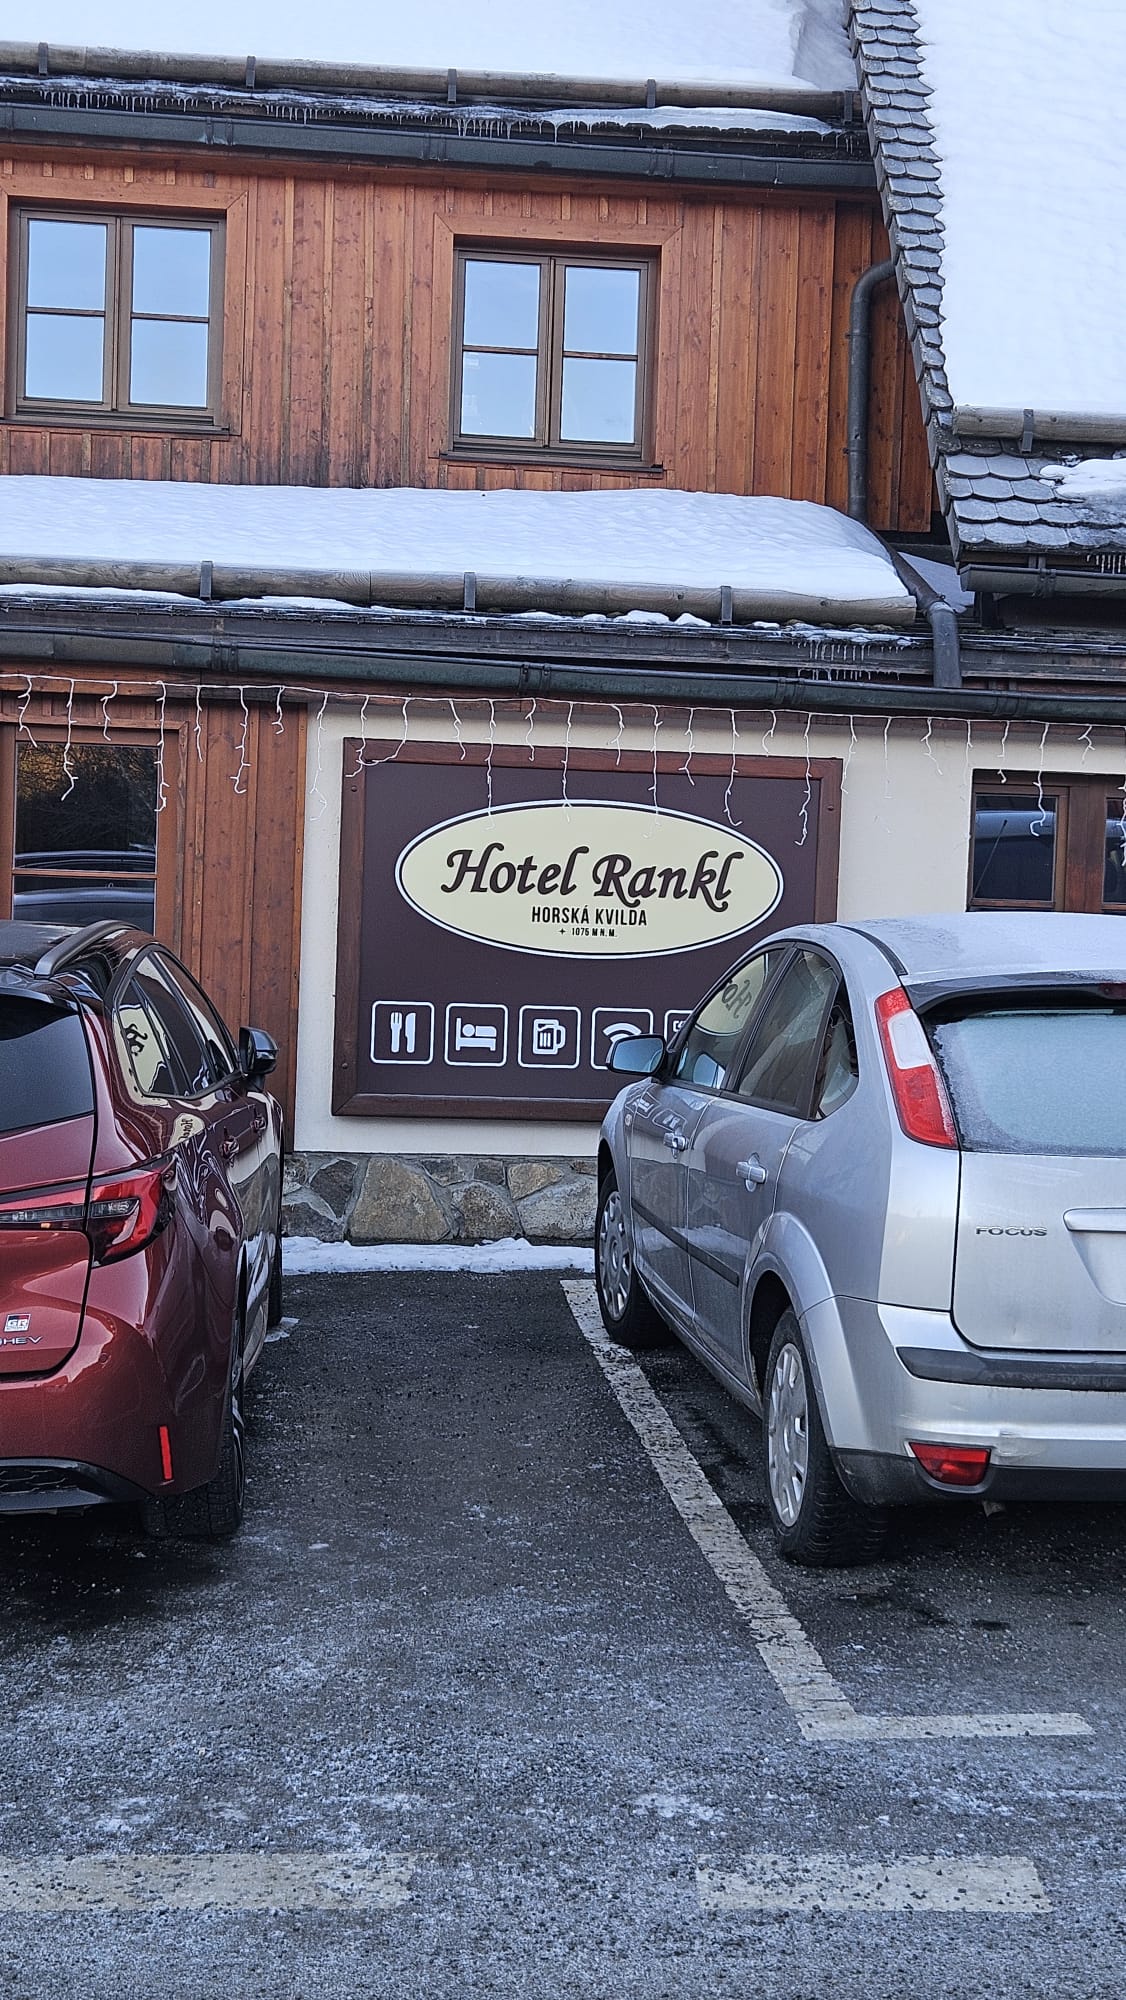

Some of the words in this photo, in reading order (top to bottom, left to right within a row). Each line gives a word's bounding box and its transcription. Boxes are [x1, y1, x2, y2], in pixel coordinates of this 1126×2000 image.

[440, 842, 590, 896] Hotel
[592, 850, 745, 913] Rankl
[531, 904, 590, 924] HORSKÁ
[595, 908, 647, 926] KVILDA
[975, 1226, 1048, 1237] FOCUS
